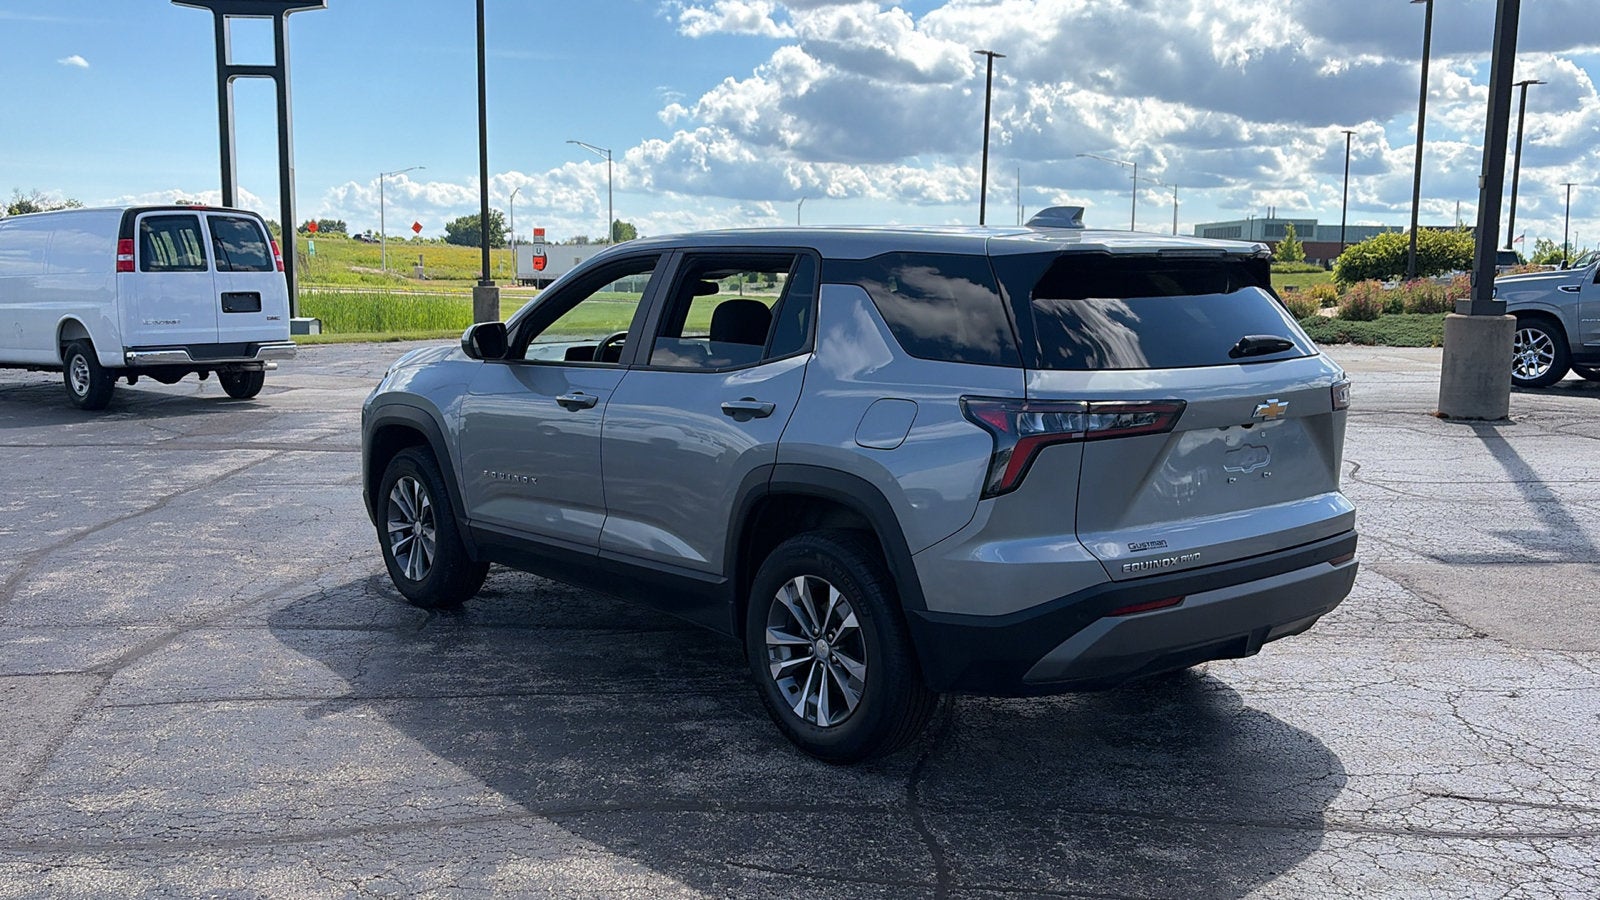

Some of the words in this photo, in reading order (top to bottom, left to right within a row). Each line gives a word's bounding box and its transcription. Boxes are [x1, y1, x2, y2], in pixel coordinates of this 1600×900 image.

[536, 247, 542, 255] U
[483, 470, 538, 485] EQUINOX
[1127, 539, 1168, 551] Gustman
[1122, 556, 1178, 574] EQUINOX
[1180, 552, 1201, 563] AWD
